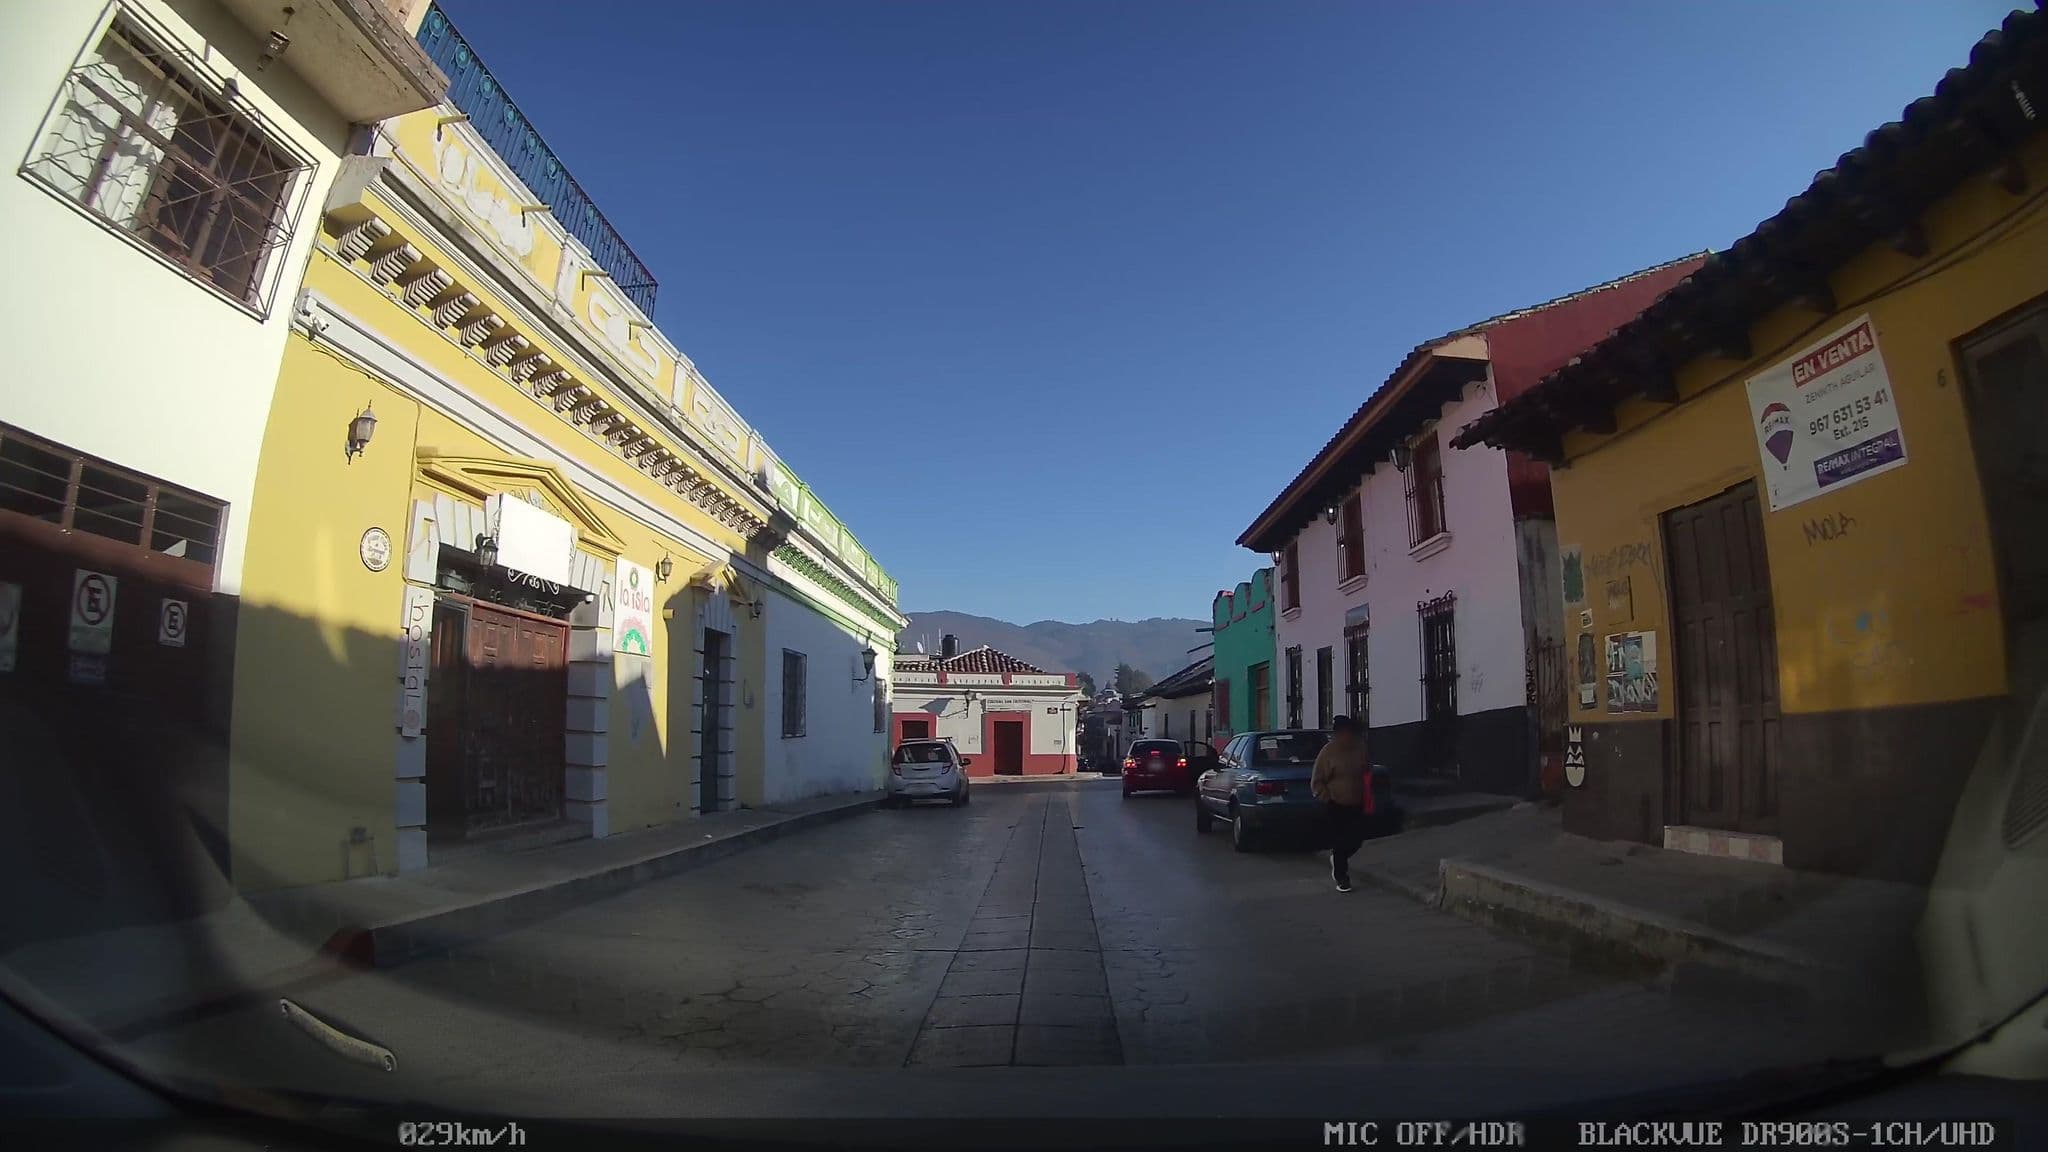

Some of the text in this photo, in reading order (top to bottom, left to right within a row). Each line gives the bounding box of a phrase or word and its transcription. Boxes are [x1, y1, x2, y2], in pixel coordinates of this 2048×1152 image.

[1794, 330, 1872, 383] EN VENTA
[1809, 387, 1889, 436] 967 631 53 41
[1833, 426, 1852, 440] Ext.
[1817, 452, 1851, 475] RE/MAX
[1851, 438, 1899, 461] INTEGRAL
[620, 579, 630, 607] la
